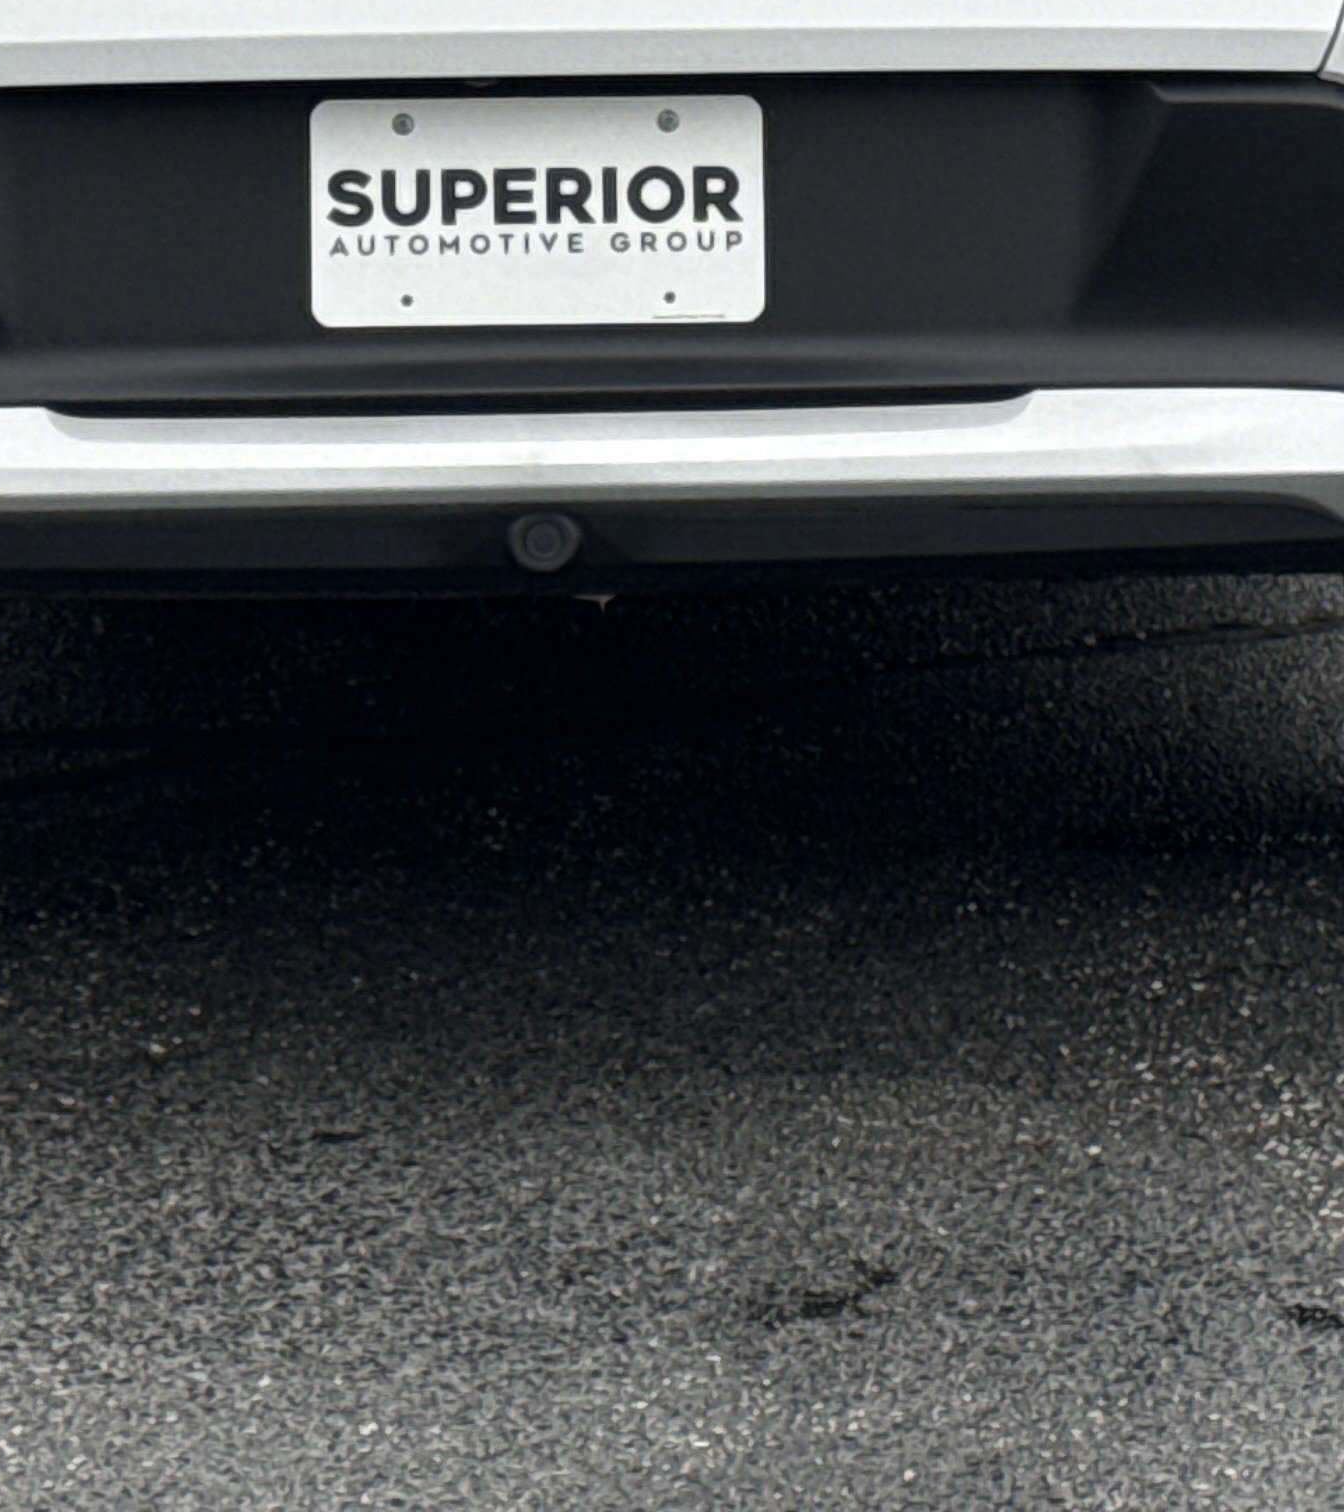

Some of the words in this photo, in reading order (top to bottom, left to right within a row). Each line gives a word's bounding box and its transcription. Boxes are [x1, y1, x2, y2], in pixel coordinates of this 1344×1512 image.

[327, 165, 742, 227] SUPERIOR
[329, 232, 584, 256] AUTOMOTIVE
[610, 230, 743, 254] GROUP
